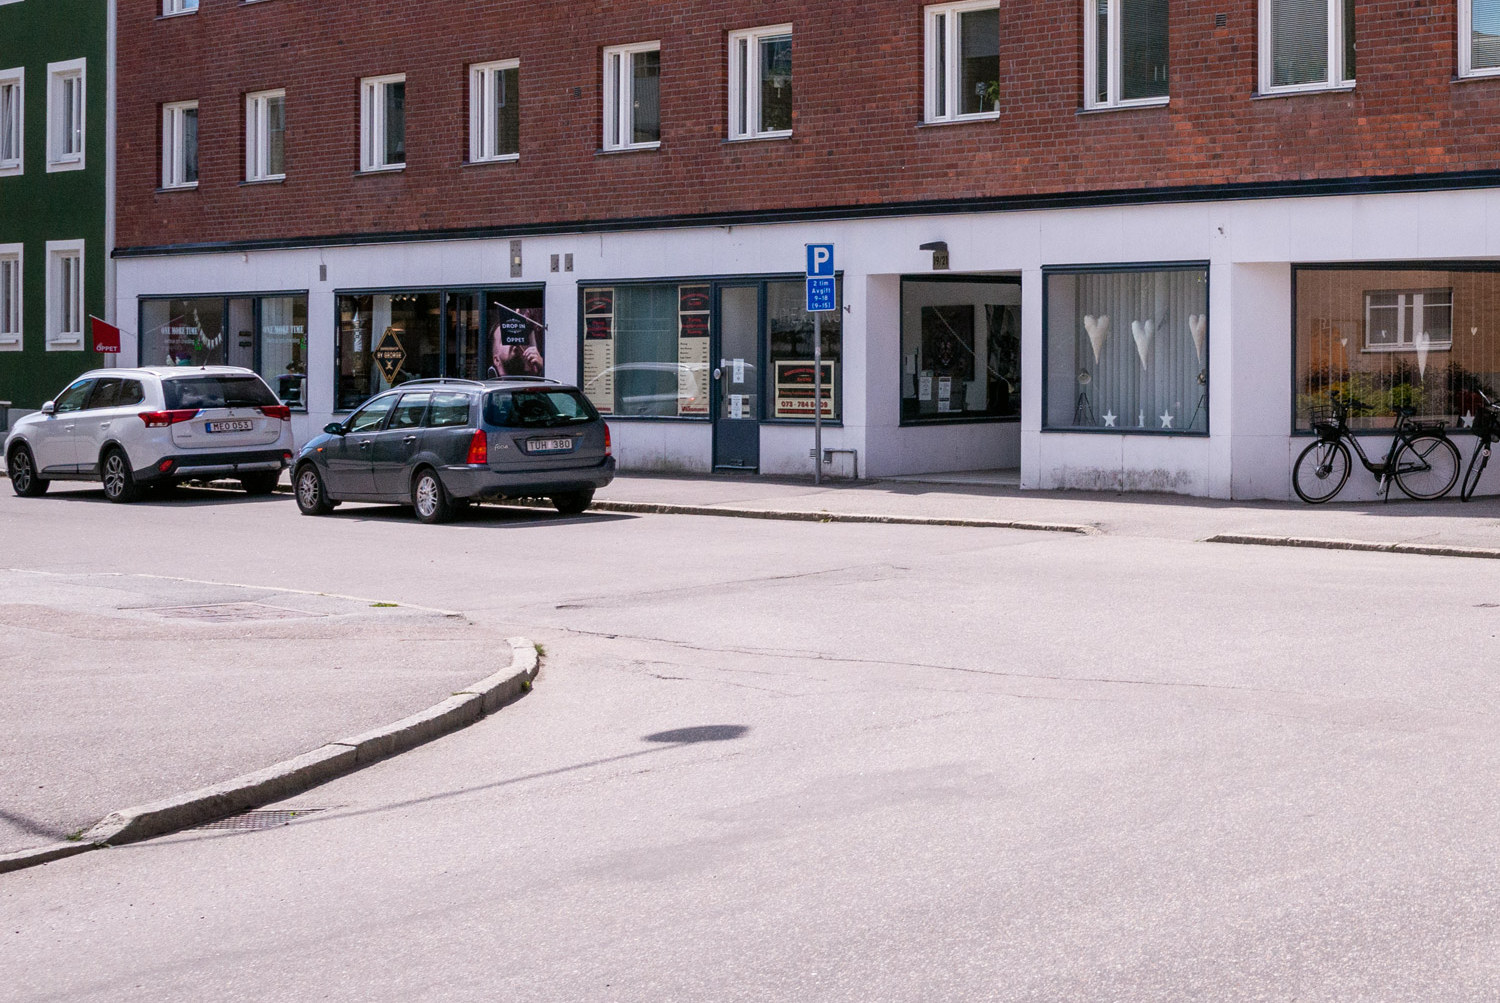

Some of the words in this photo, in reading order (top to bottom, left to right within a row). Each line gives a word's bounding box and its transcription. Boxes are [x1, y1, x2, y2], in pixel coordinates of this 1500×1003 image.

[814, 247, 830, 273] P
[811, 287, 831, 295] Avgift
[232, 421, 249, 429] 053
[529, 441, 547, 450] TUH
[553, 439, 571, 448] 380
